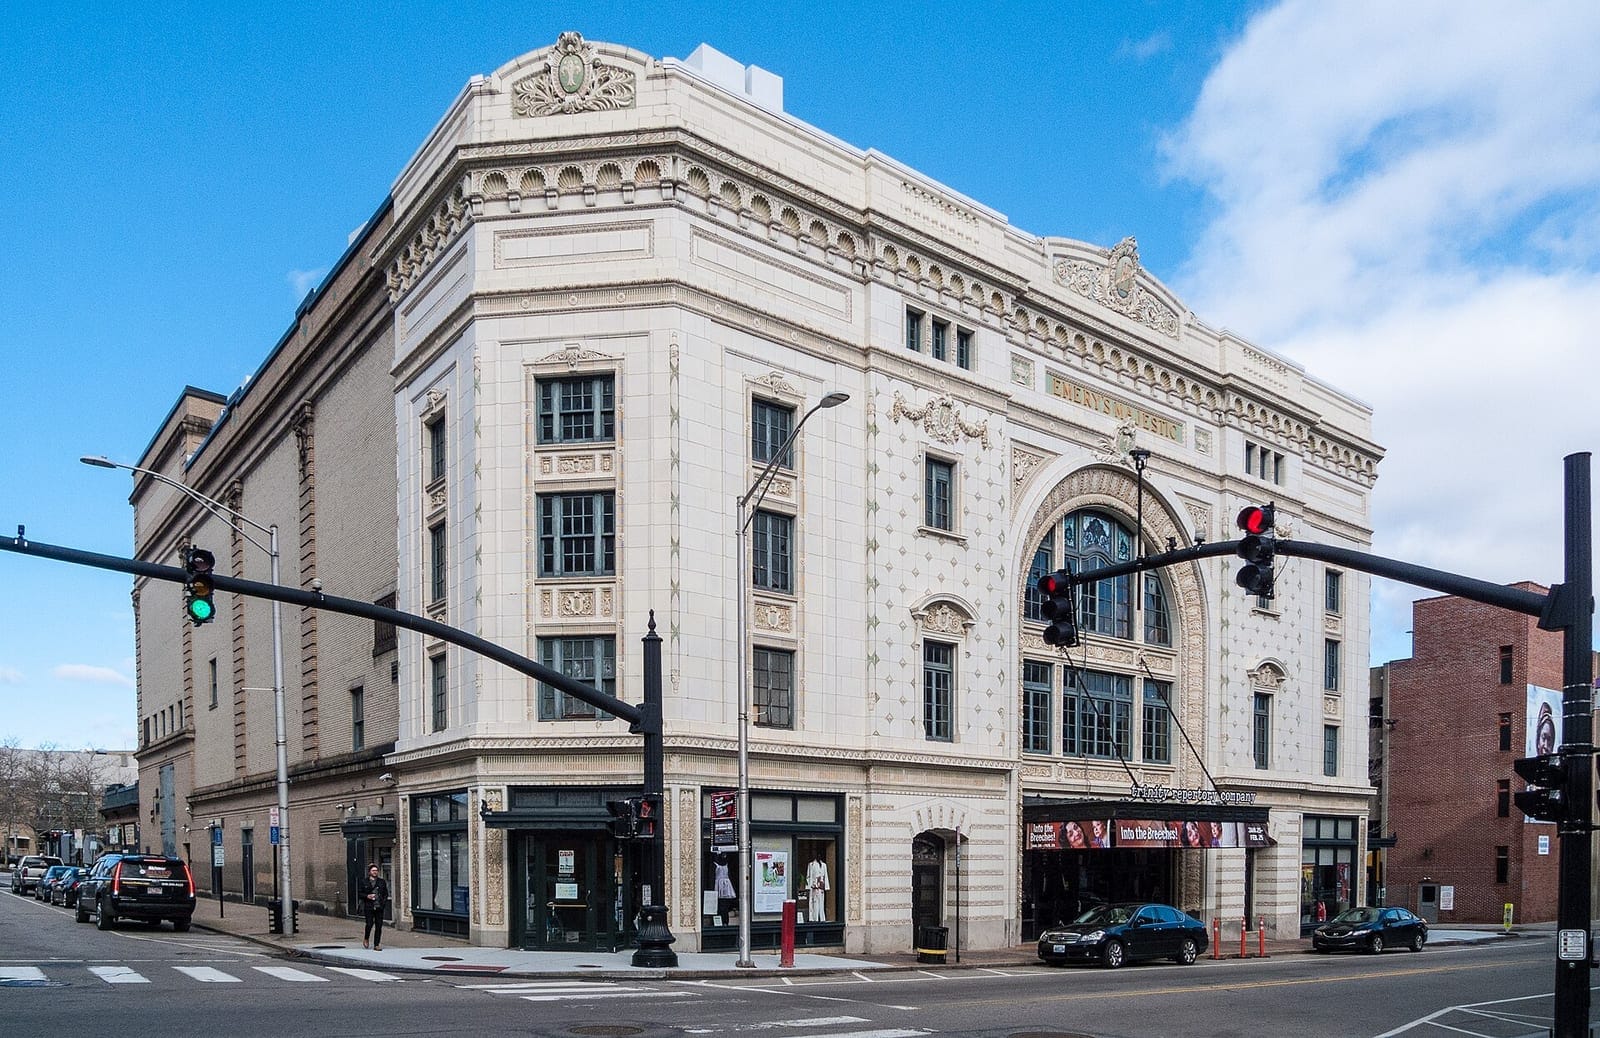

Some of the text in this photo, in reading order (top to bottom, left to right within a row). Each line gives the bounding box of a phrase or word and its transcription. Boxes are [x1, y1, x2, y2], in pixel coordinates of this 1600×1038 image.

[1053, 378, 1177, 440] EMERY'S MAJESTIC
[1131, 785, 1256, 804] trinity repertory company
[1033, 823, 1054, 832] Into the
[1120, 827, 1178, 840] Into the Breeches!
[1030, 832, 1056, 842] Breeches!
